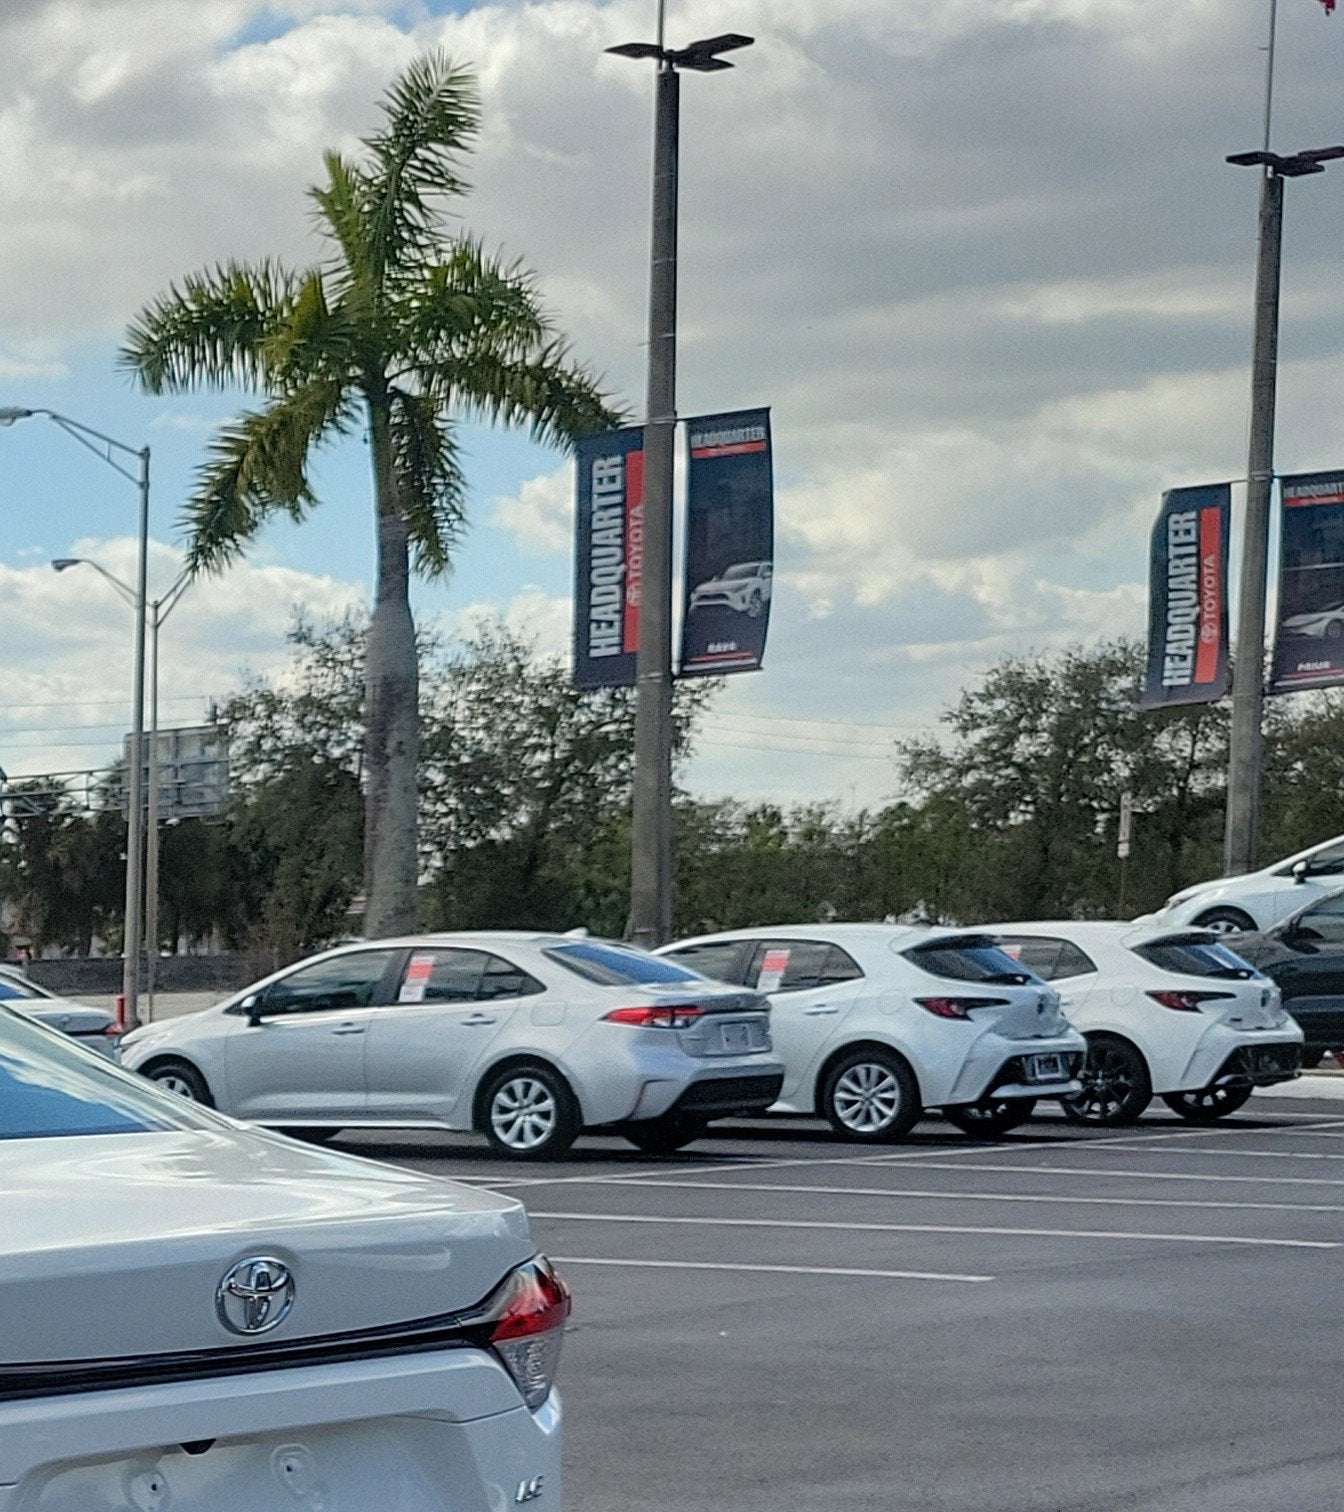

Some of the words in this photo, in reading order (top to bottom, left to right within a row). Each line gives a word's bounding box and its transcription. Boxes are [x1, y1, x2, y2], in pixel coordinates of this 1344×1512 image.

[589, 454, 627, 658] HEADQUARTER
[1162, 509, 1199, 687] HEADQUARTER
[1201, 555, 1216, 620] TOYOTA
[514, 1474, 544, 1503] LE
